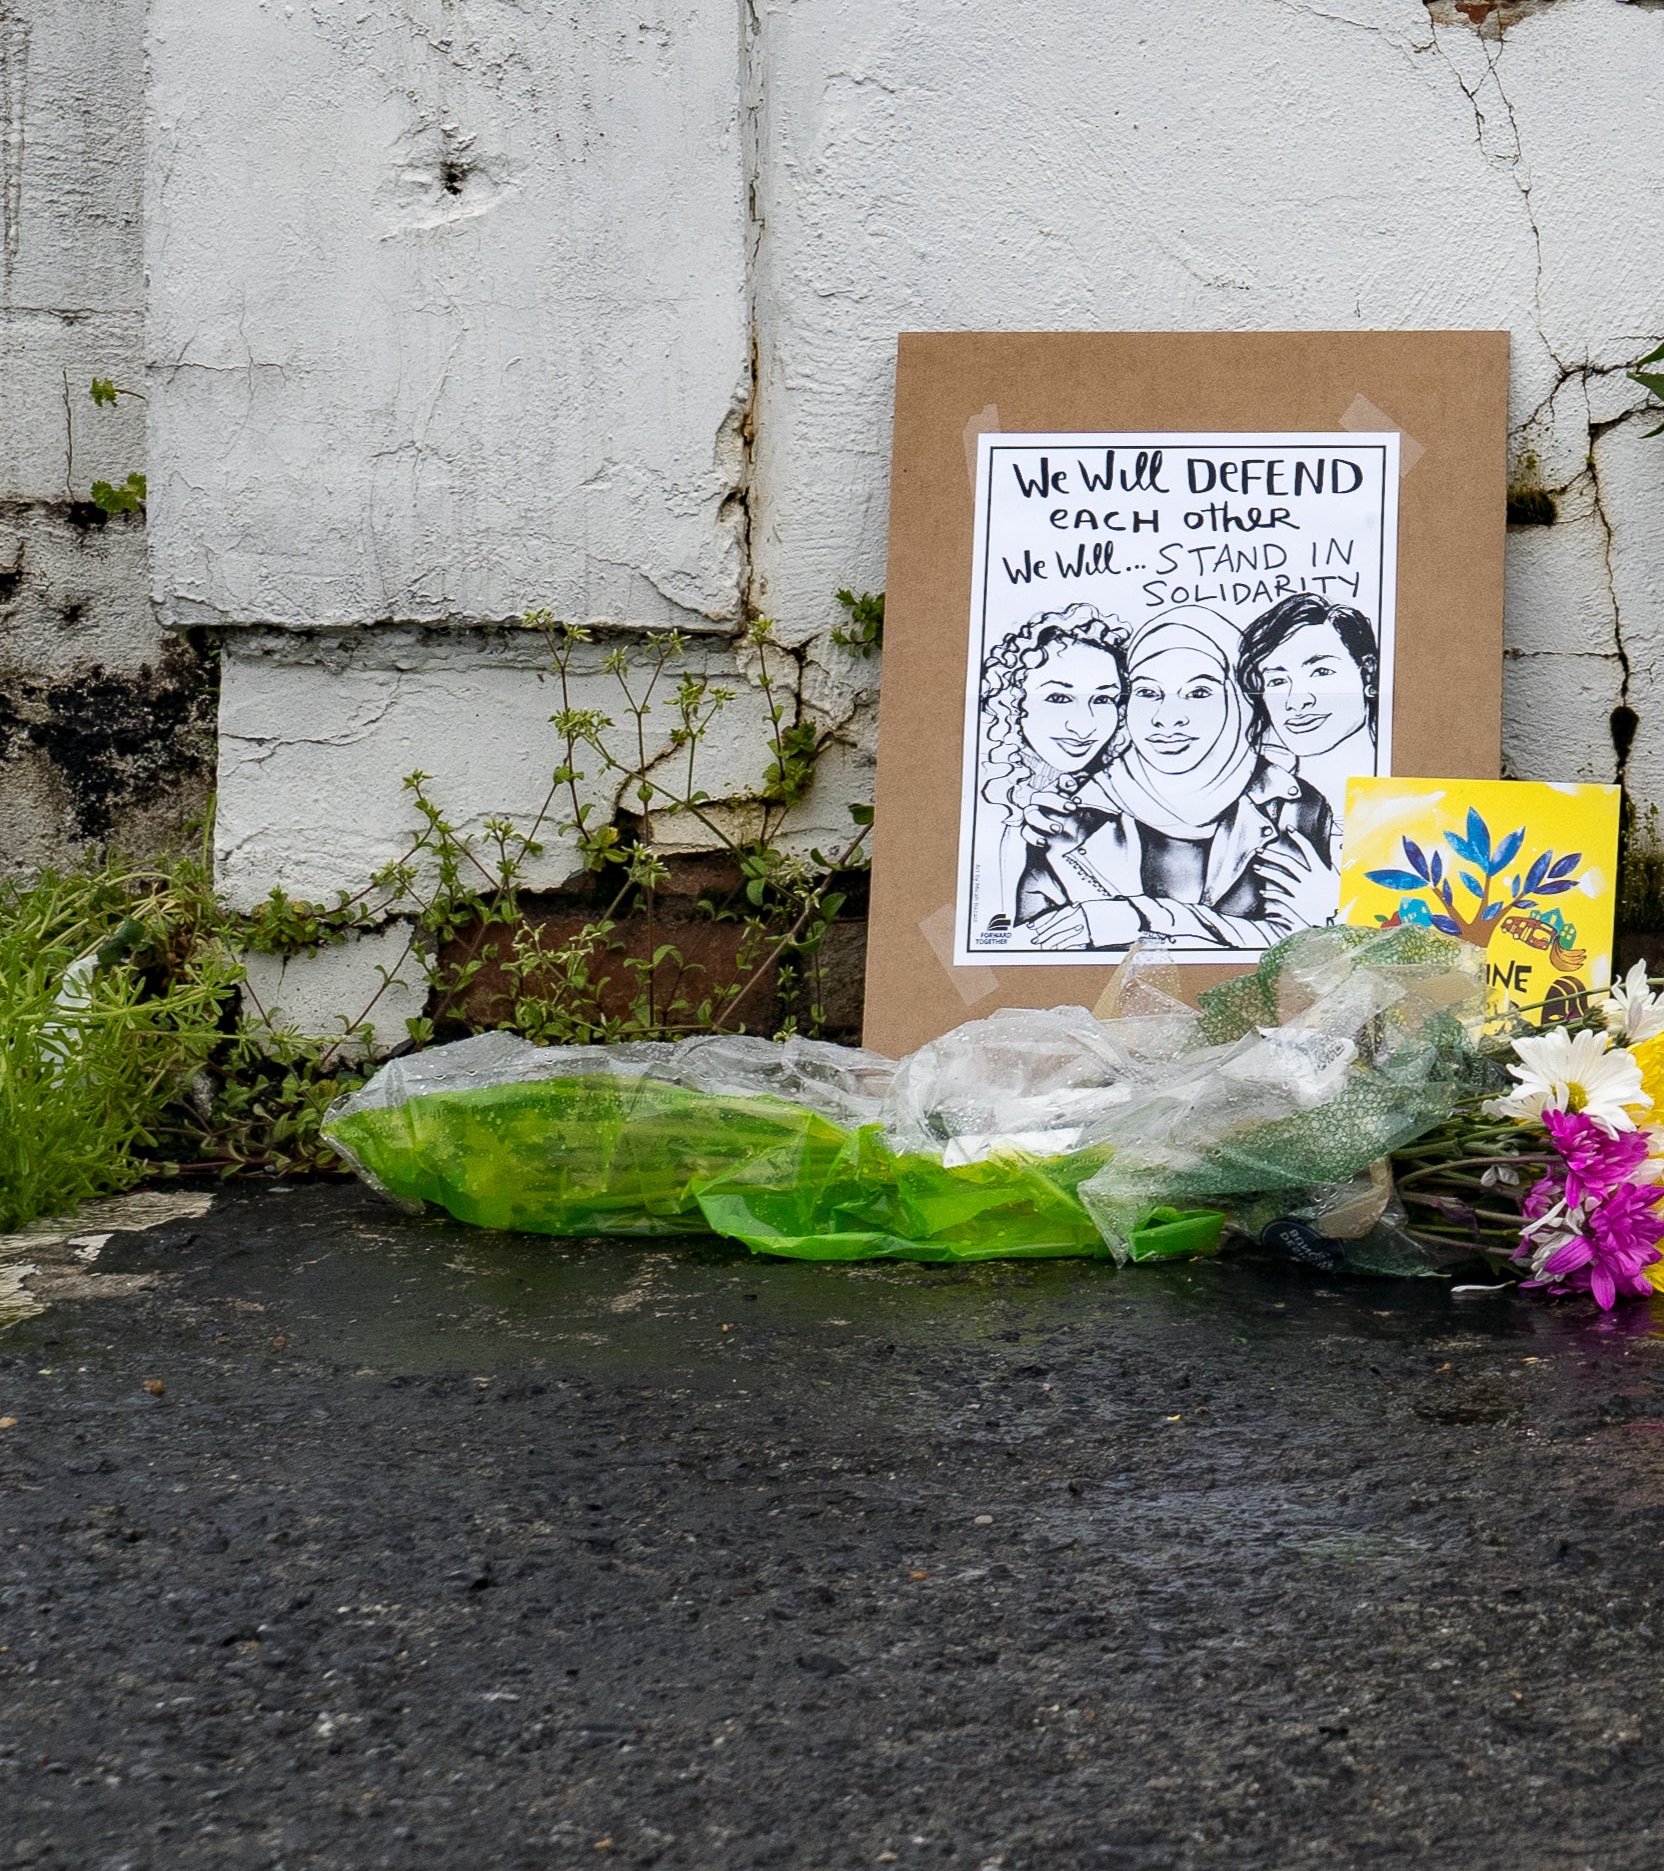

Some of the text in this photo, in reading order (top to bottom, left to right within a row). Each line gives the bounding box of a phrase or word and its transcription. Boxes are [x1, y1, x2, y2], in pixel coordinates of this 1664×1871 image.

[1013, 457, 1070, 499] We
[1078, 449, 1170, 494] Will
[1002, 549, 1047, 584] We
[1155, 542, 1288, 577] STAND
[1311, 538, 1355, 568] IN
[1142, 571, 1361, 608] SOLIDARITY
